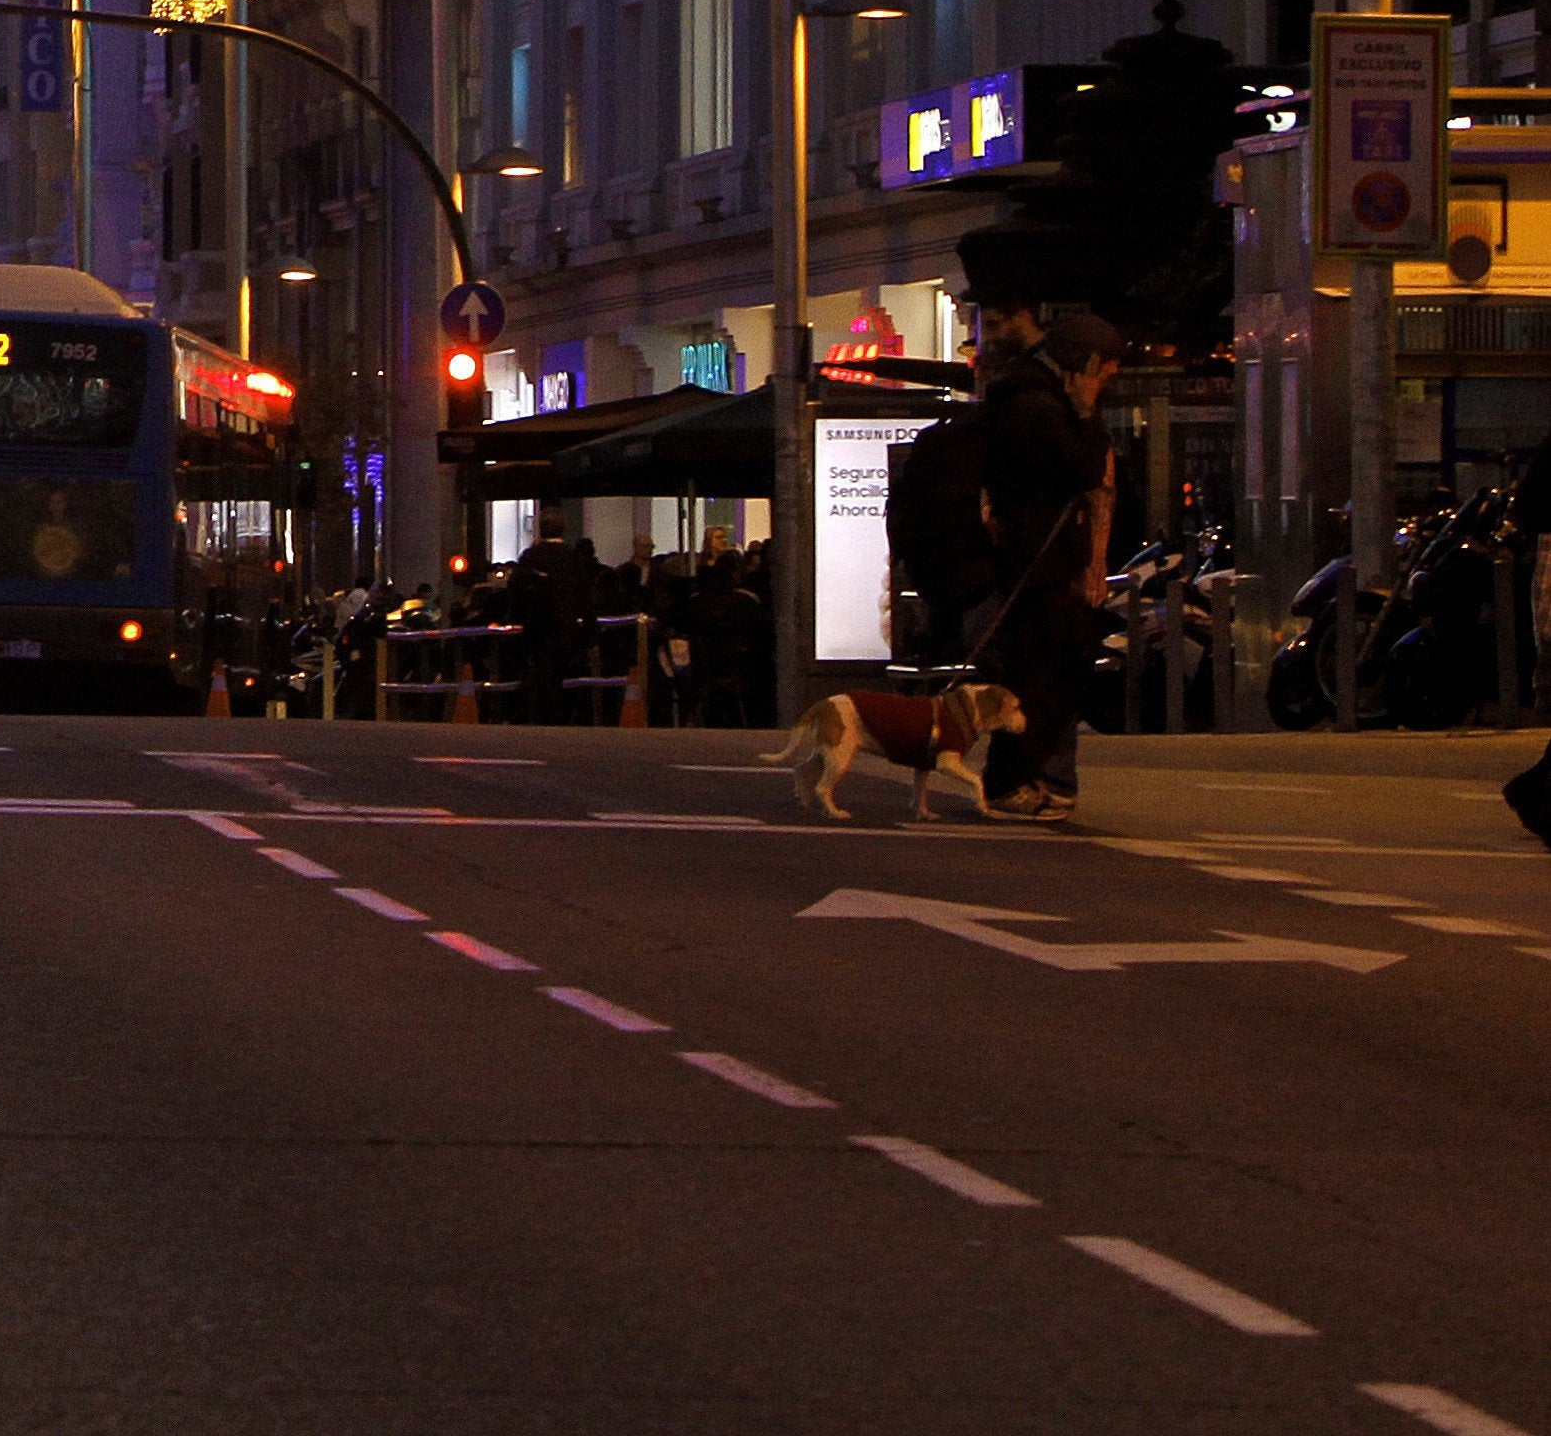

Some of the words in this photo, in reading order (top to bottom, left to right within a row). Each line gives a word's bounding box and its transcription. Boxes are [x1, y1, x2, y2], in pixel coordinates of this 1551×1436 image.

[1339, 58, 1422, 71] EXCLUSIVO
[50, 342, 99, 362] 7952
[827, 430, 892, 440] SAMSUNG
